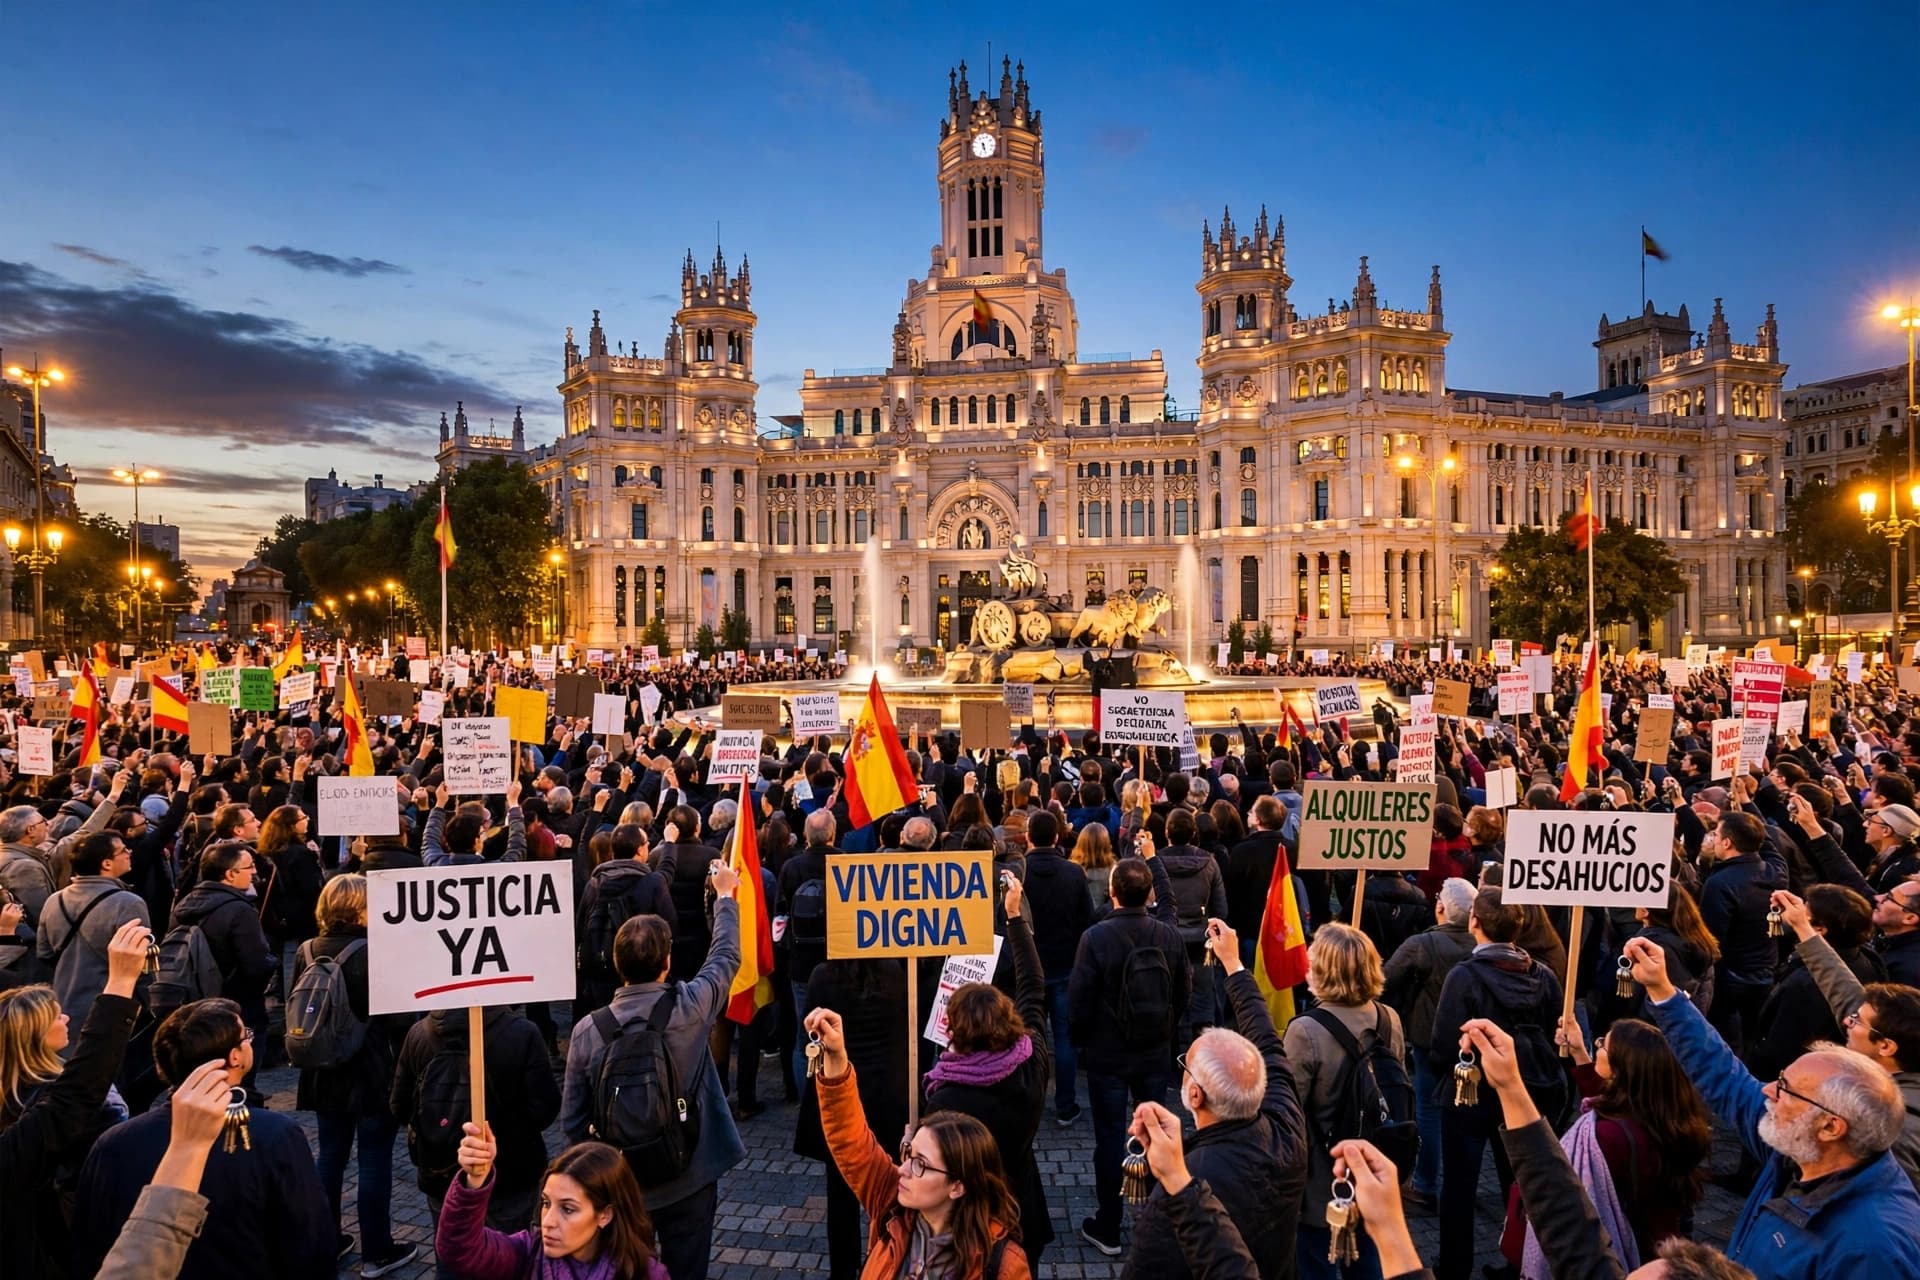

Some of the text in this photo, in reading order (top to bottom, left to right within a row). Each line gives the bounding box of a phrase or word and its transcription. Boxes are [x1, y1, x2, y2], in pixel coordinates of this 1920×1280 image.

[1305, 789, 1431, 823] ALQUILERES
[1321, 828, 1407, 861] JUSTOS
[1538, 818, 1638, 857] NO MÁS
[831, 861, 988, 903] VIVIENDA
[1508, 858, 1666, 894] DESAHUCIOS
[383, 874, 561, 925] JUSTICIA
[856, 906, 967, 949] DIGNA
[437, 926, 510, 976] YA
